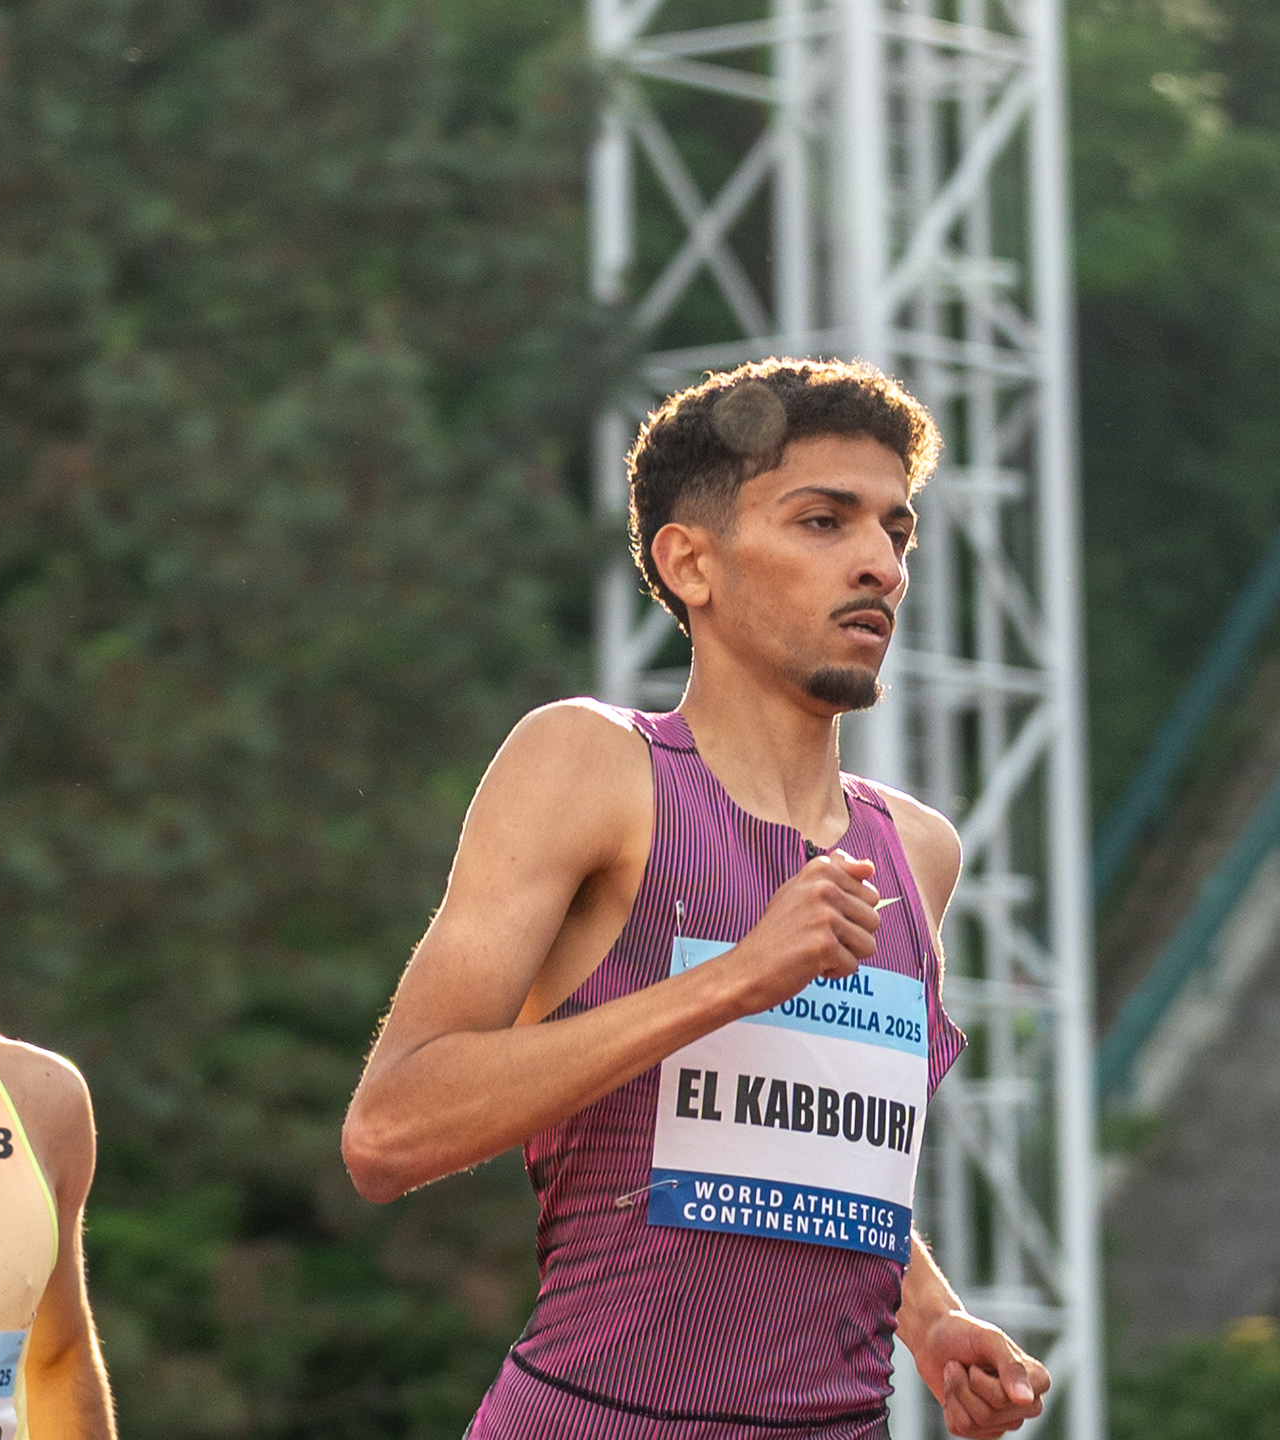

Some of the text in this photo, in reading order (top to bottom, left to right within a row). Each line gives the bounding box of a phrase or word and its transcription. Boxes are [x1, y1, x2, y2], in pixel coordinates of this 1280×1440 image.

[780, 997, 922, 1043] ODLOŽILA 2025
[676, 1068, 916, 1154] EL KABBOURI
[683, 1202, 896, 1251] CONTINENTAL TOUR
[694, 1180, 894, 1228] WORLD ATHLETICS
